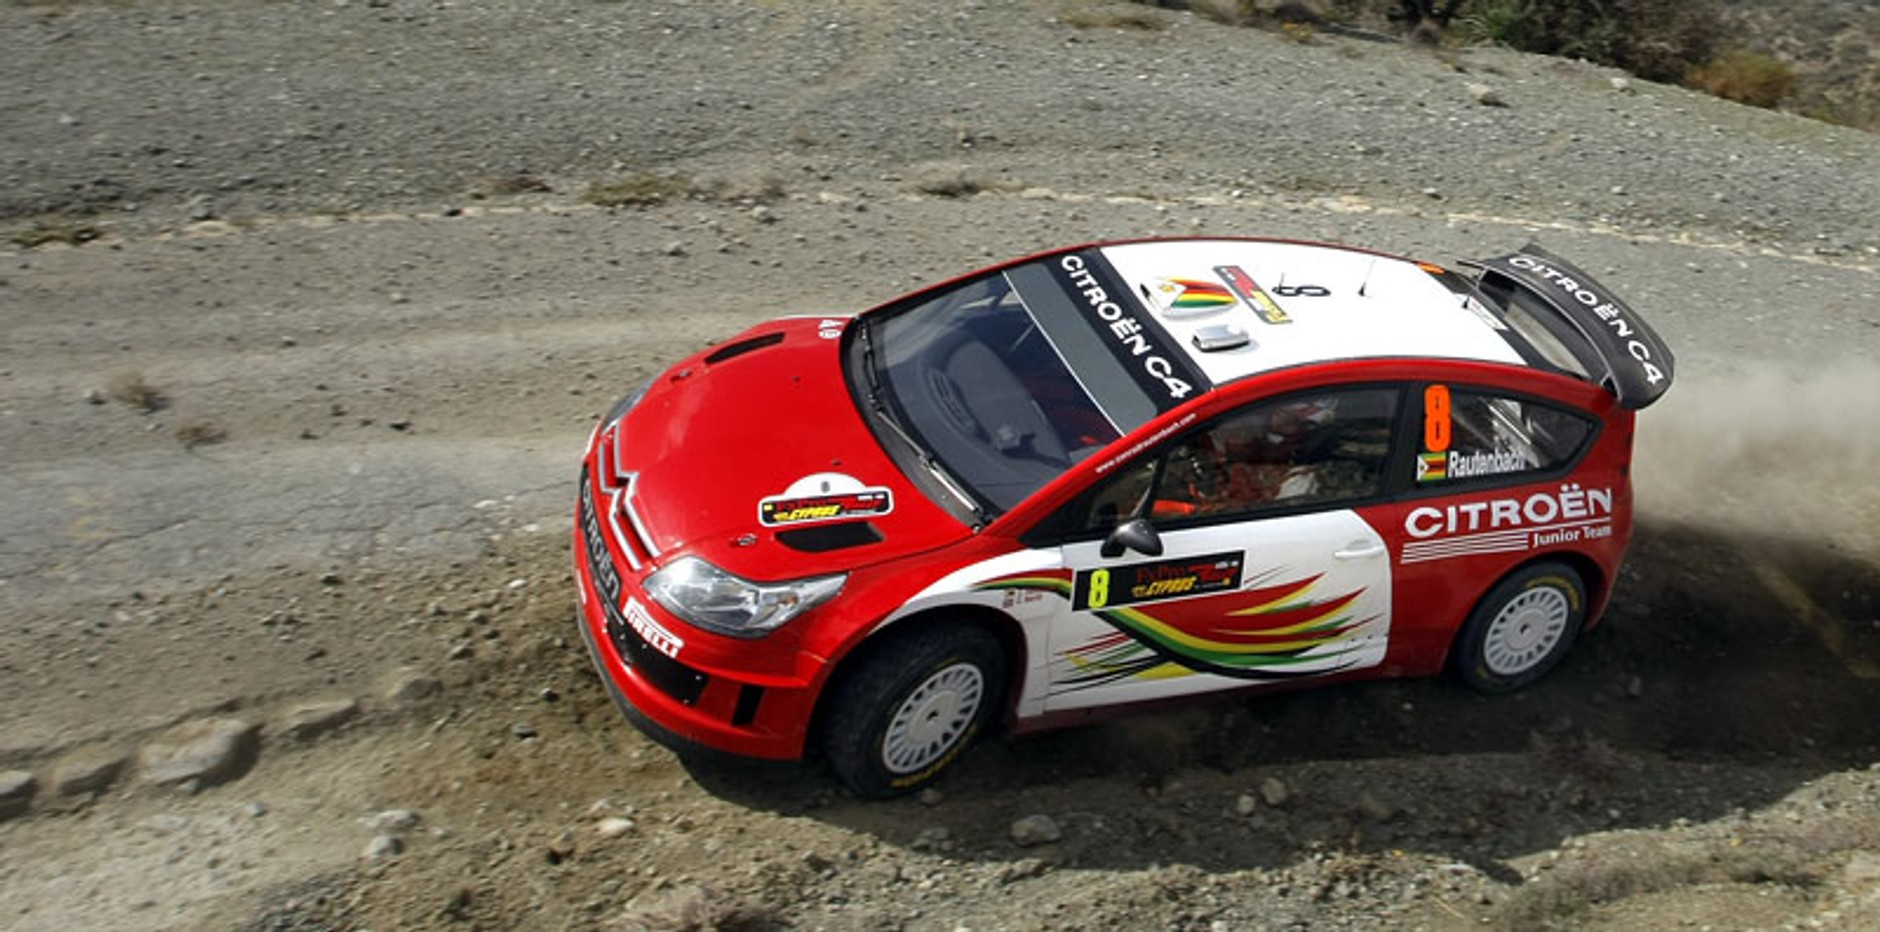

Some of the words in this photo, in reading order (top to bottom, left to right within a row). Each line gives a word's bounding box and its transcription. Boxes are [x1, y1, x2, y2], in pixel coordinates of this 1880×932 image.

[1271, 285, 1331, 297] 8
[1061, 255, 1151, 356] CITROËN
[1145, 357, 1192, 398] C4
[1508, 257, 1634, 337] CITROËN
[1628, 340, 1664, 385] C4
[1424, 384, 1450, 452] 8
[1447, 450, 1526, 478] Rautenbach
[1404, 483, 1612, 538] CITROËN
[1532, 529, 1580, 549] Junior
[1583, 523, 1613, 540] Team
[1088, 568, 1111, 609] 8
[624, 597, 685, 659] PIRELLI
